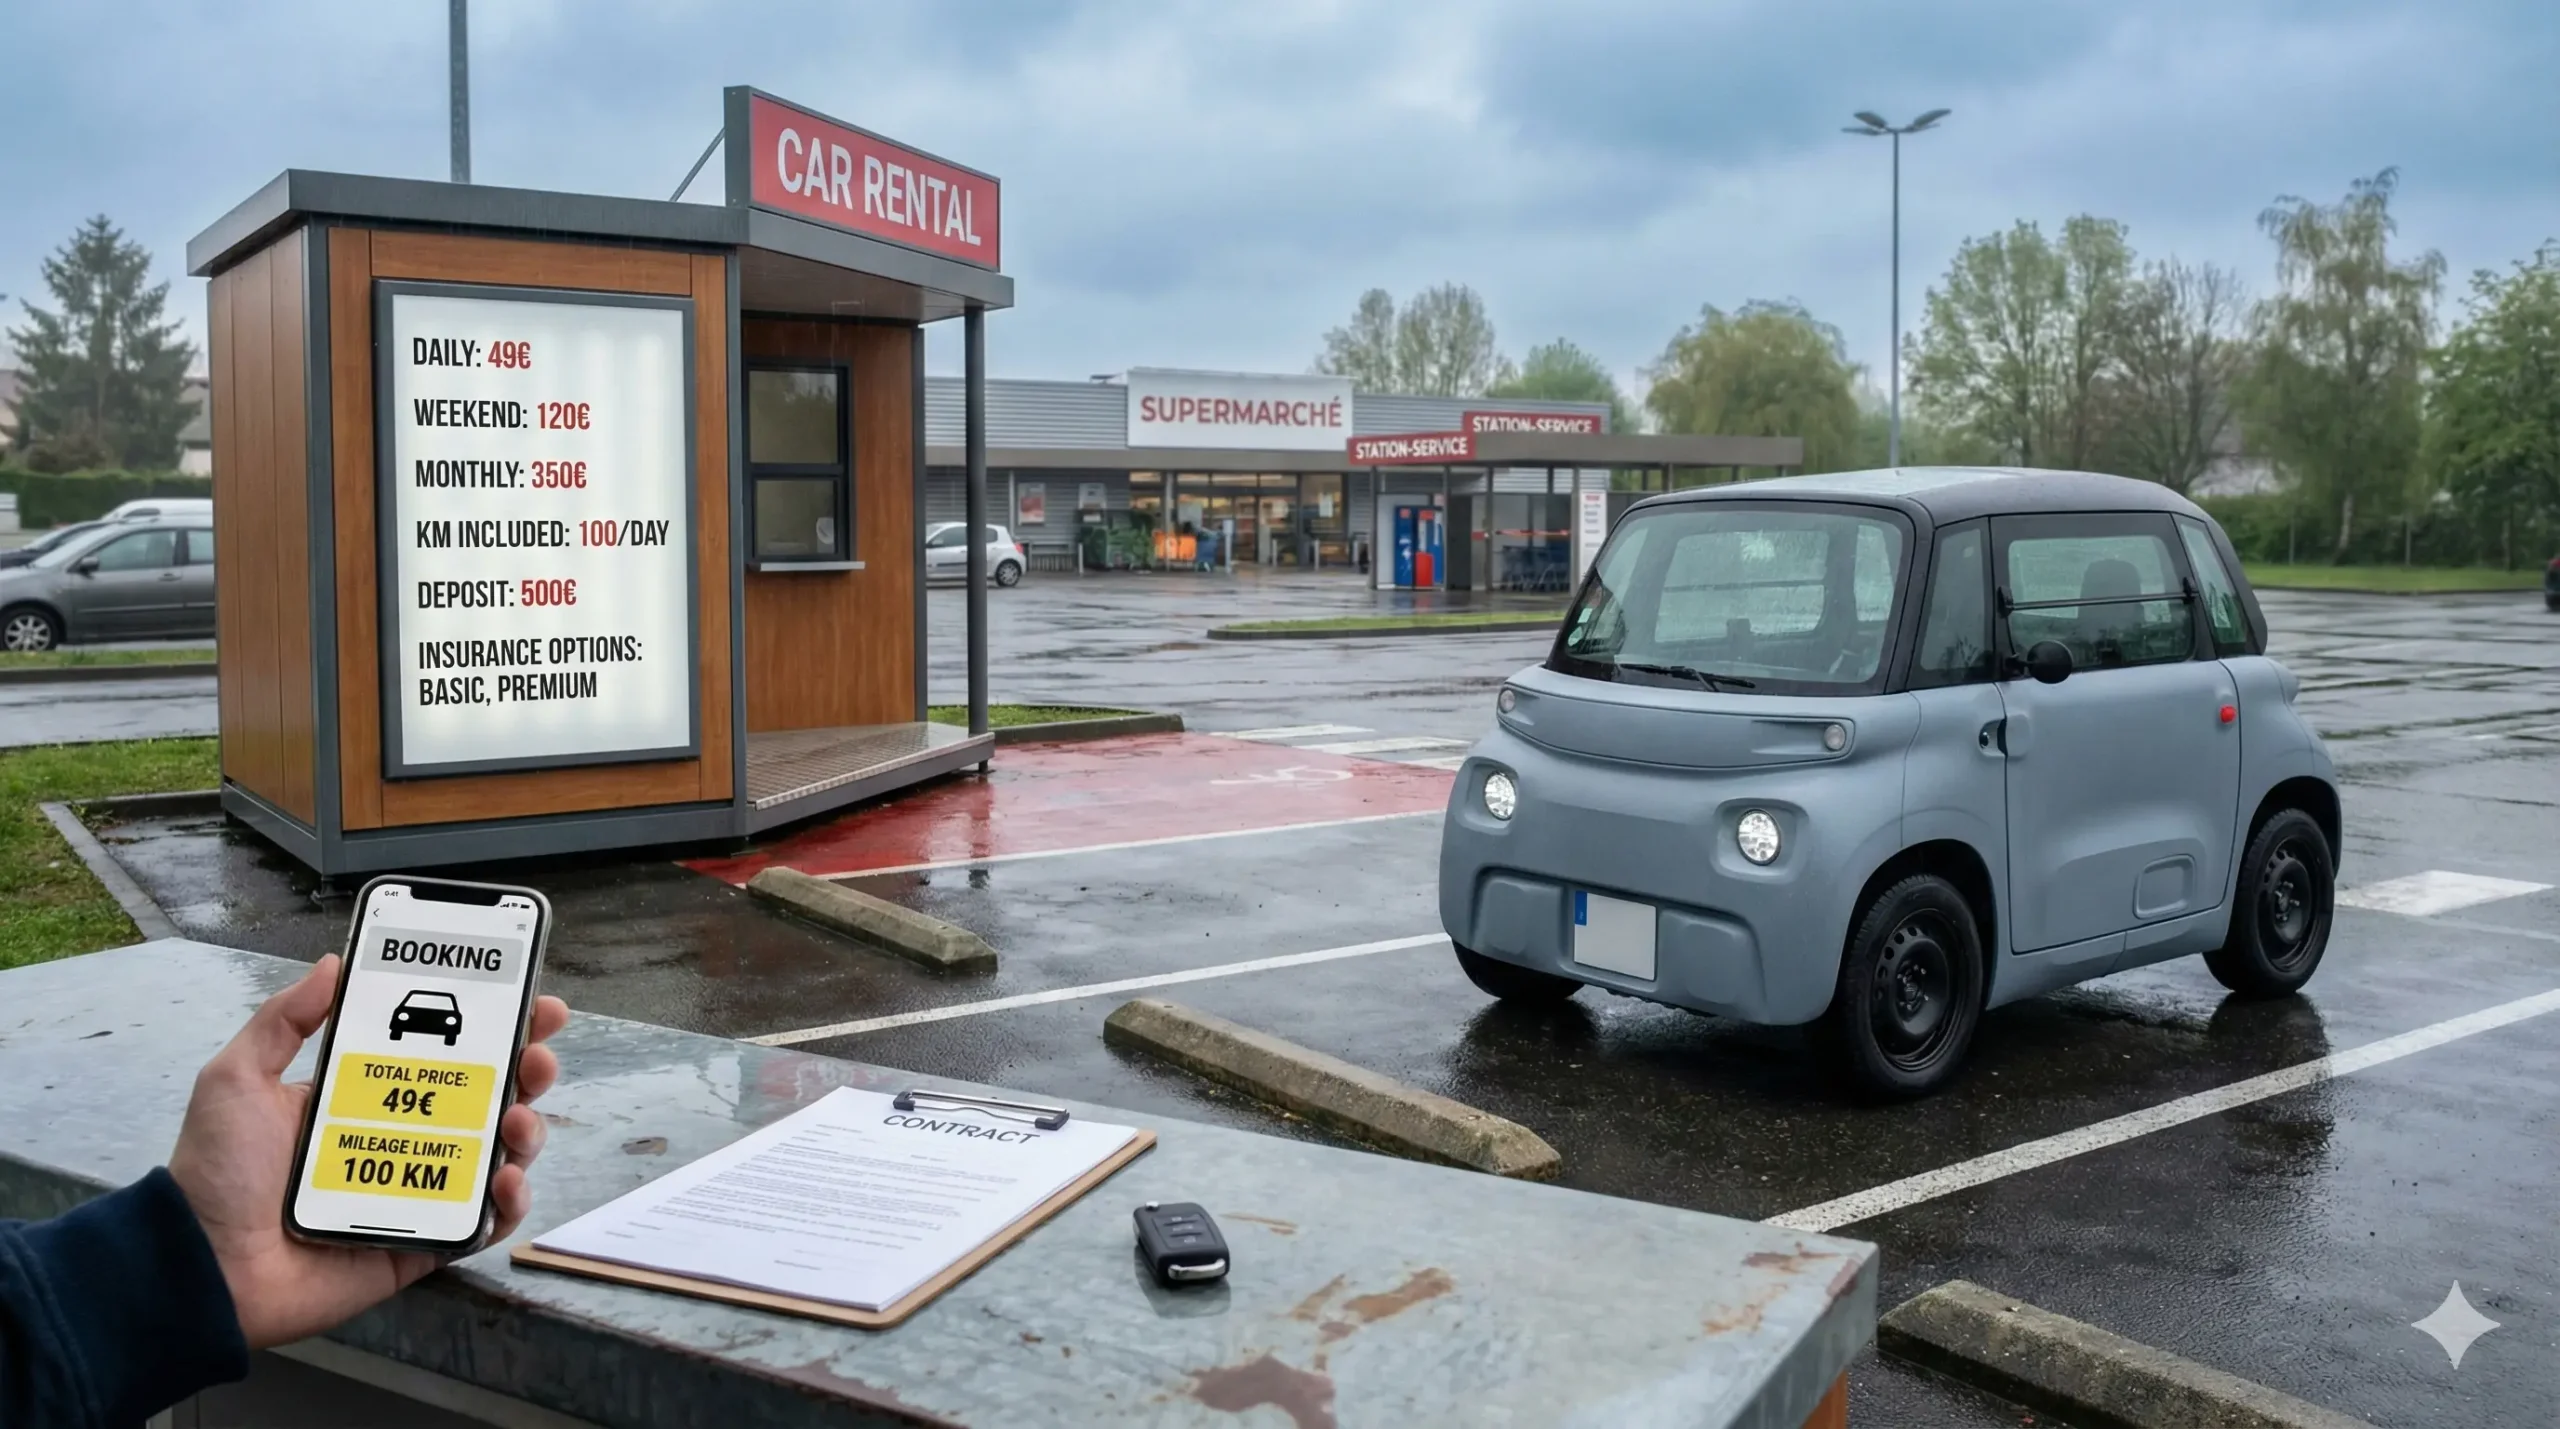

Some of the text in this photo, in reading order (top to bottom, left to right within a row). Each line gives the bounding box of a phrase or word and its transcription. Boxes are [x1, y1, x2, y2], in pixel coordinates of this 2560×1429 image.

[777, 127, 981, 246] CAR RENTAL
[413, 338, 531, 370] DAILY: 49€
[414, 399, 591, 430] WEEKEND: 120€
[1141, 395, 1342, 427] SUPERMARCHÉ
[1472, 415, 1593, 433] STATION-SERVICE
[1356, 436, 1469, 459] STATION-SERVICE
[415, 460, 587, 489] MONTHLY: 350€
[416, 519, 670, 548] KM INCLUDED: 100/DAY
[417, 578, 577, 608] DEPOSIT: 500€
[419, 635, 643, 669] INSURANCE OPTIONS:
[419, 671, 598, 706] BASIC, PREMIUM
[381, 938, 502, 972] BOOKING
[364, 1063, 469, 1087] TOTAL PRICE:
[382, 1087, 436, 1116] 49€
[883, 1114, 1040, 1144] CONTRACT
[338, 1133, 463, 1160] MILEAGE LIMIT:
[344, 1157, 449, 1191] 100 KM
